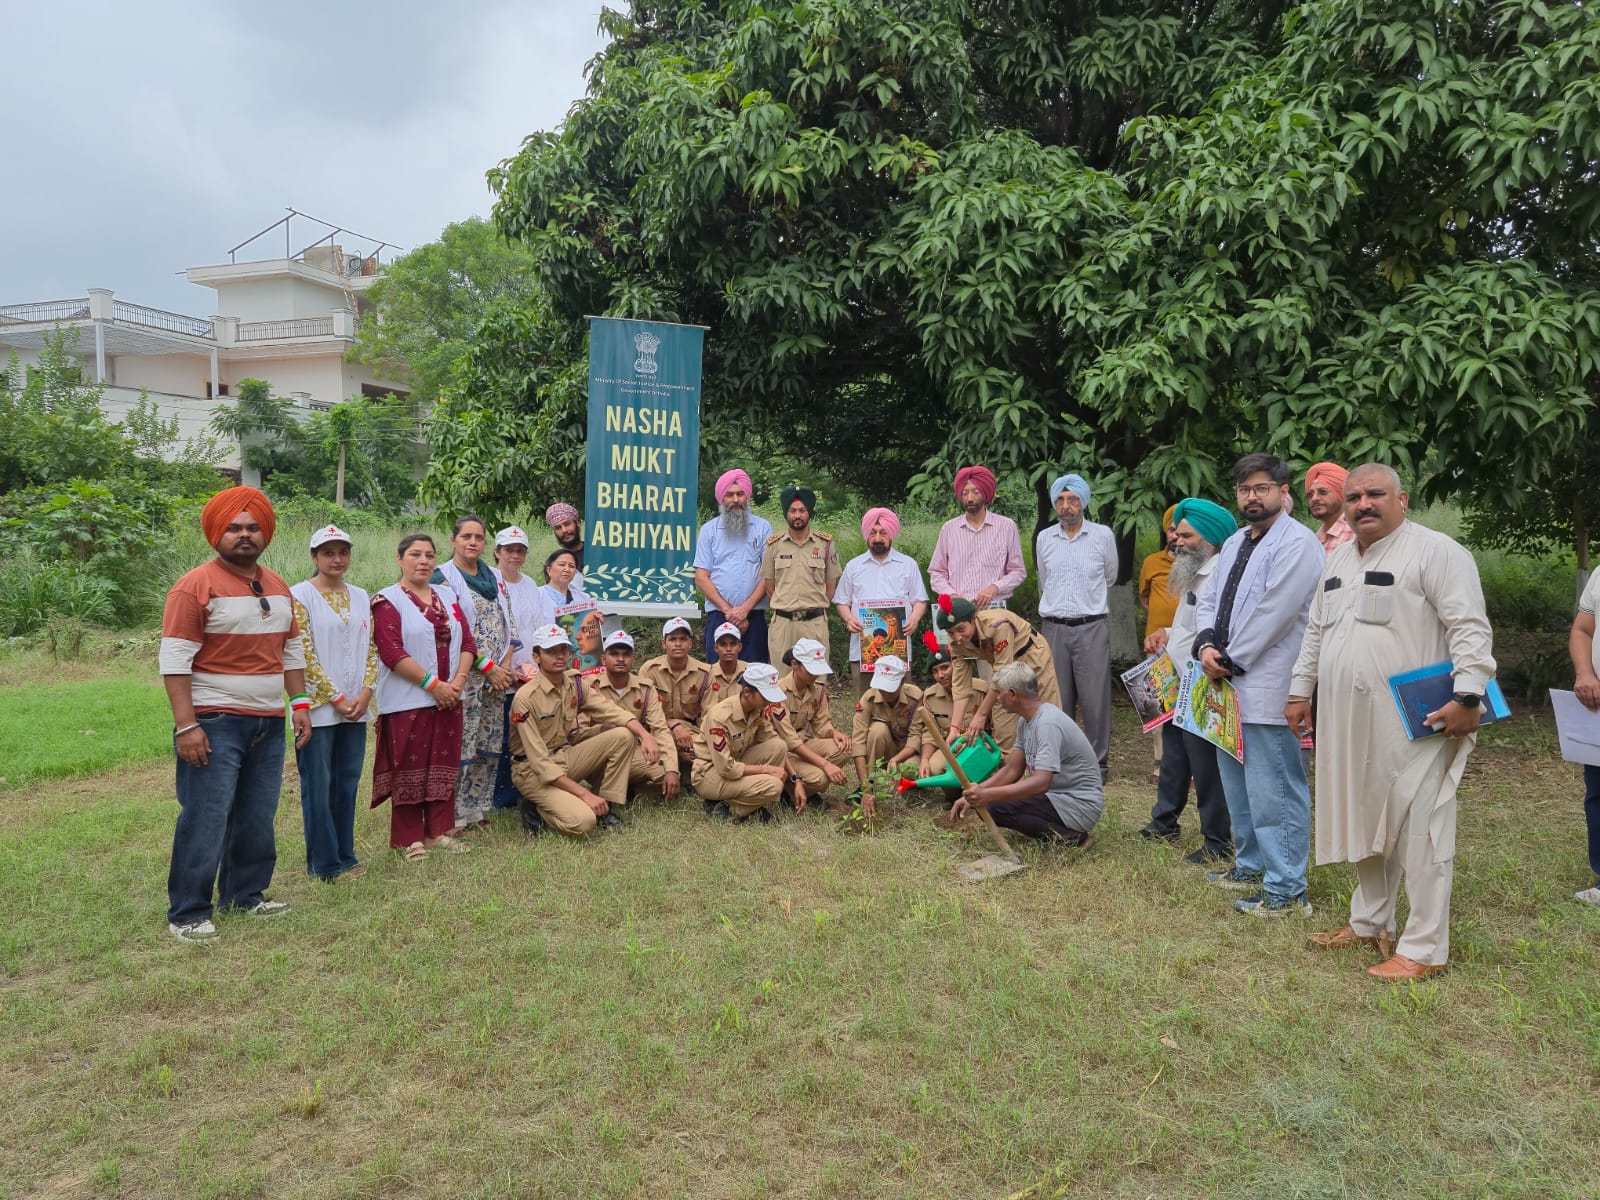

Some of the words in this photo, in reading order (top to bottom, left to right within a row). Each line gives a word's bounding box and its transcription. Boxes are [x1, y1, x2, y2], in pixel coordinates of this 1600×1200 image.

[606, 404, 683, 437] NASHA
[611, 444, 675, 475] MUKT
[597, 482, 687, 513] BHARAT
[591, 520, 691, 551] ABHIYAN
